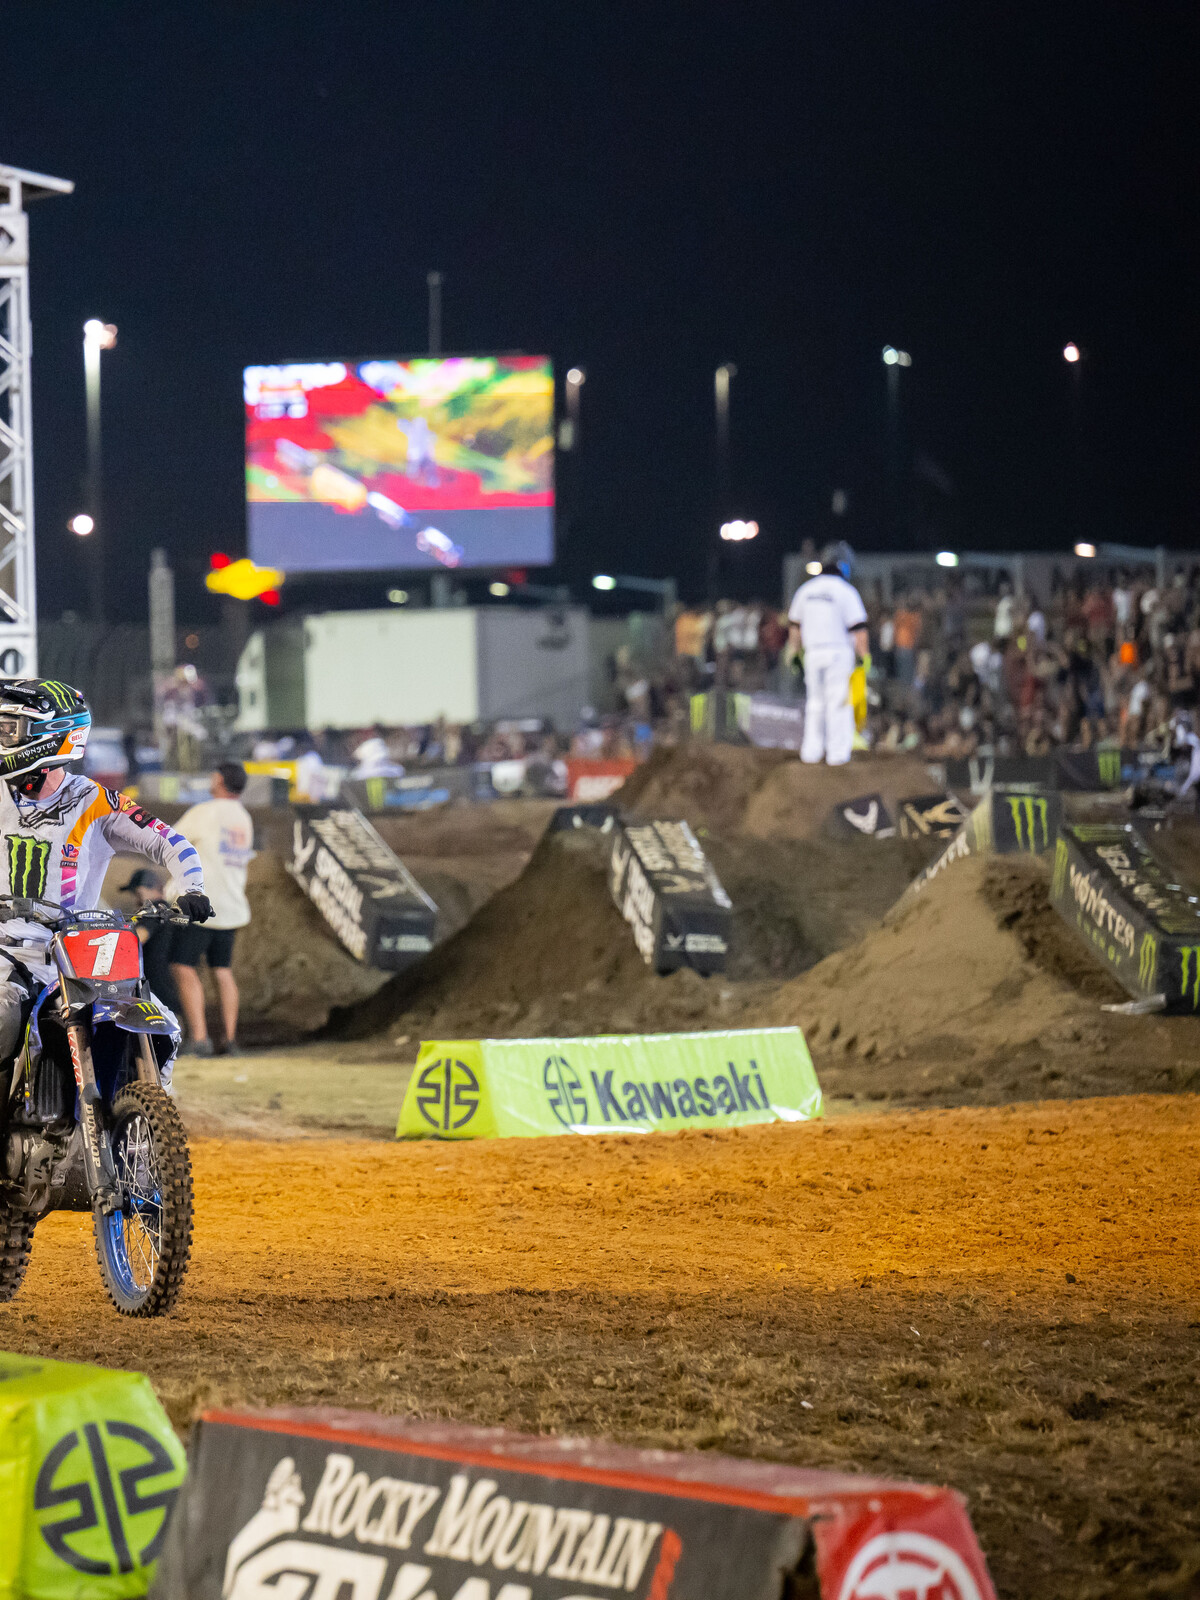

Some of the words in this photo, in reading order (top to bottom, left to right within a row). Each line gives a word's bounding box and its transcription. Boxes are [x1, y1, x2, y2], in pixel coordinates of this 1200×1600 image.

[17, 740, 58, 760] MONSTER
[70, 732, 84, 742] BELL
[88, 932, 120, 977] 1
[591, 1059, 770, 1122] Kawasaki
[84, 1103, 102, 1168] DUNLOP
[302, 1452, 440, 1550] ROCKY
[424, 1474, 663, 1592] MOUNTAIN
